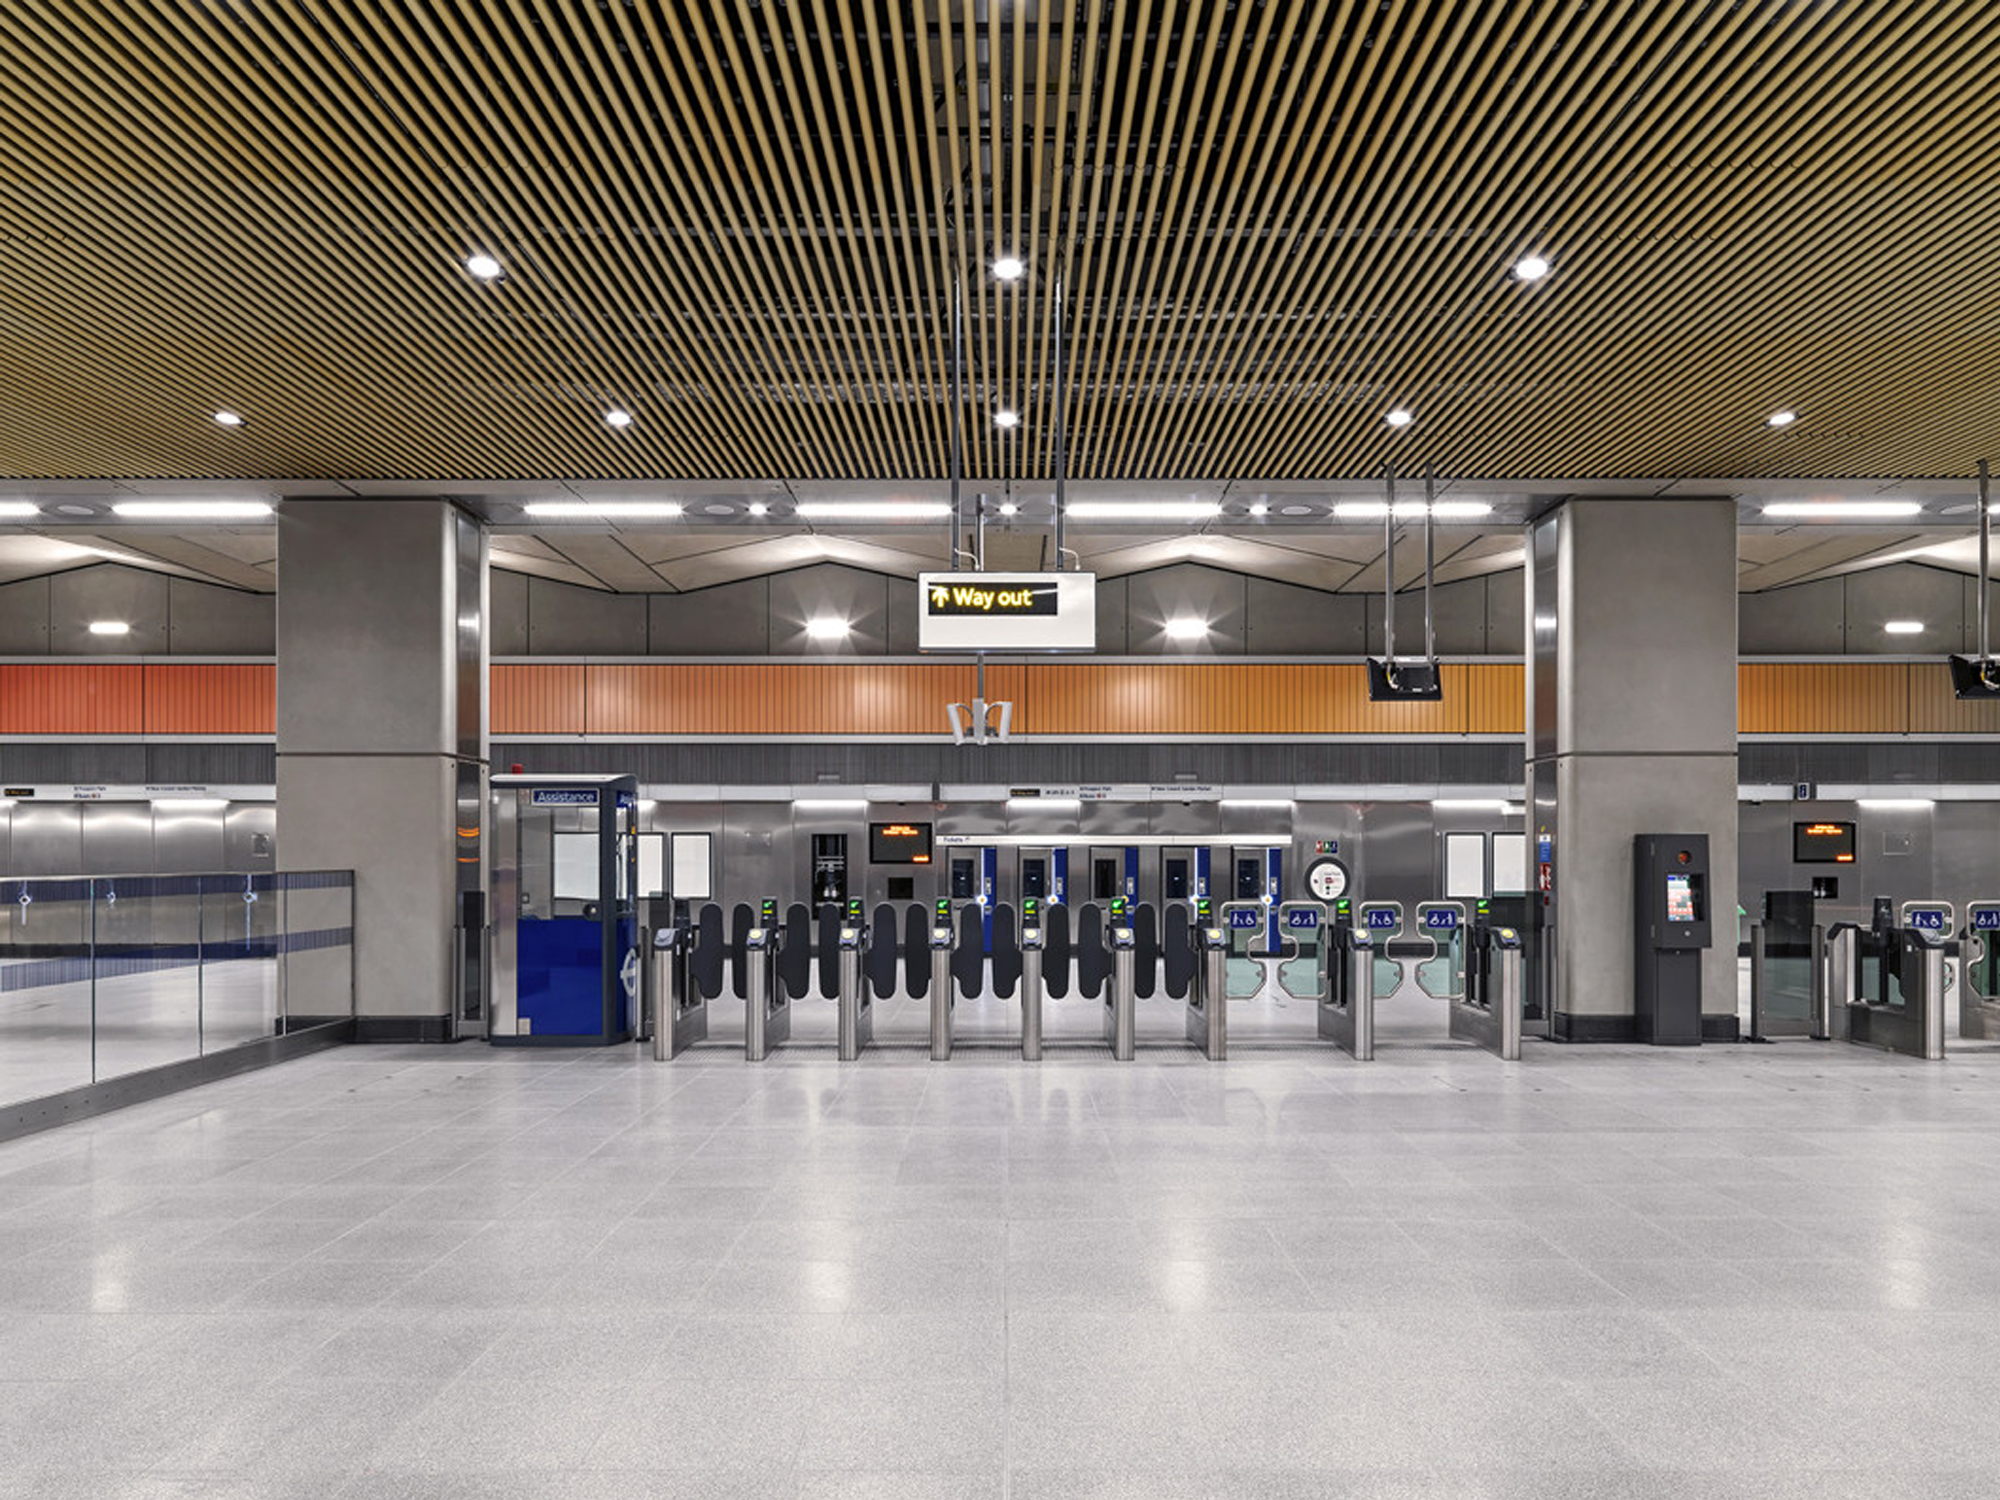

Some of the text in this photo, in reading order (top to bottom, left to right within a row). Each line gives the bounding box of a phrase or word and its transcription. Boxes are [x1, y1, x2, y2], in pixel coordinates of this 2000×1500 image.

[952, 587, 1033, 610] Way out
[537, 791, 595, 802] Assistance
